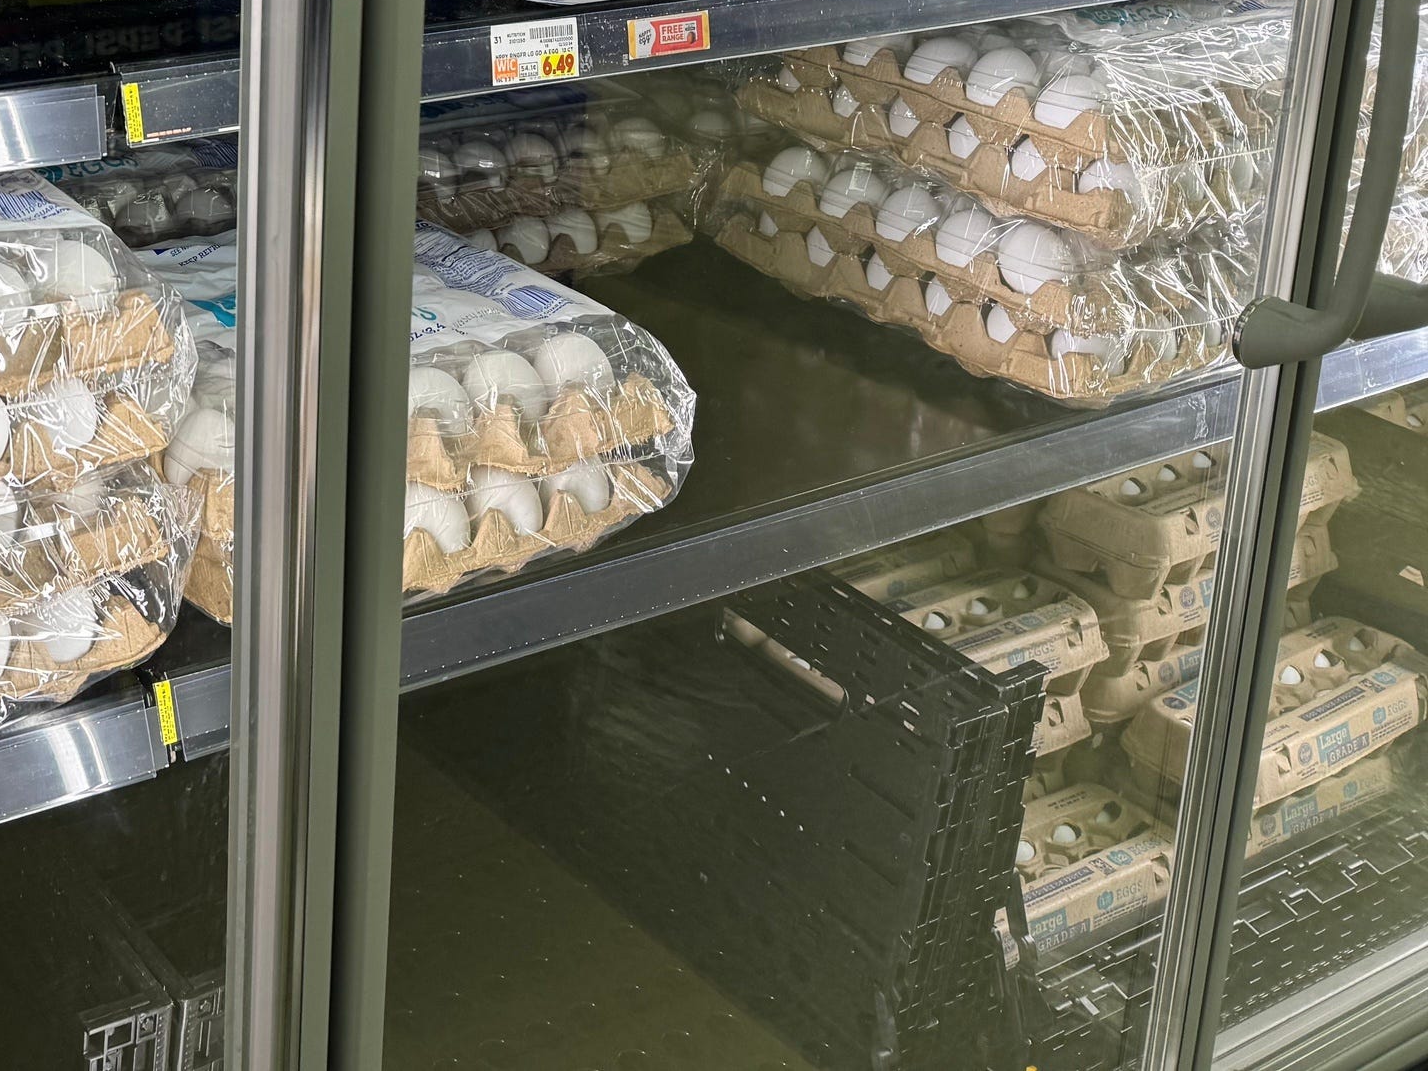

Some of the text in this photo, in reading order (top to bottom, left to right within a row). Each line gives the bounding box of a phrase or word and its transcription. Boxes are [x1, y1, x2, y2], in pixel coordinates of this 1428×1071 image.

[661, 24, 683, 35] FREE
[662, 34, 684, 42] RANGE
[494, 36, 502, 44] 31
[496, 58, 517, 72] WIC
[542, 53, 574, 76] 6.49
[178, 253, 198, 267] KEEP
[1026, 640, 1056, 660] EGGS
[1318, 726, 1348, 750] Large
[1328, 737, 1369, 763] GRADE A
[1283, 799, 1316, 822] Large
[1115, 880, 1143, 901] EGGS
